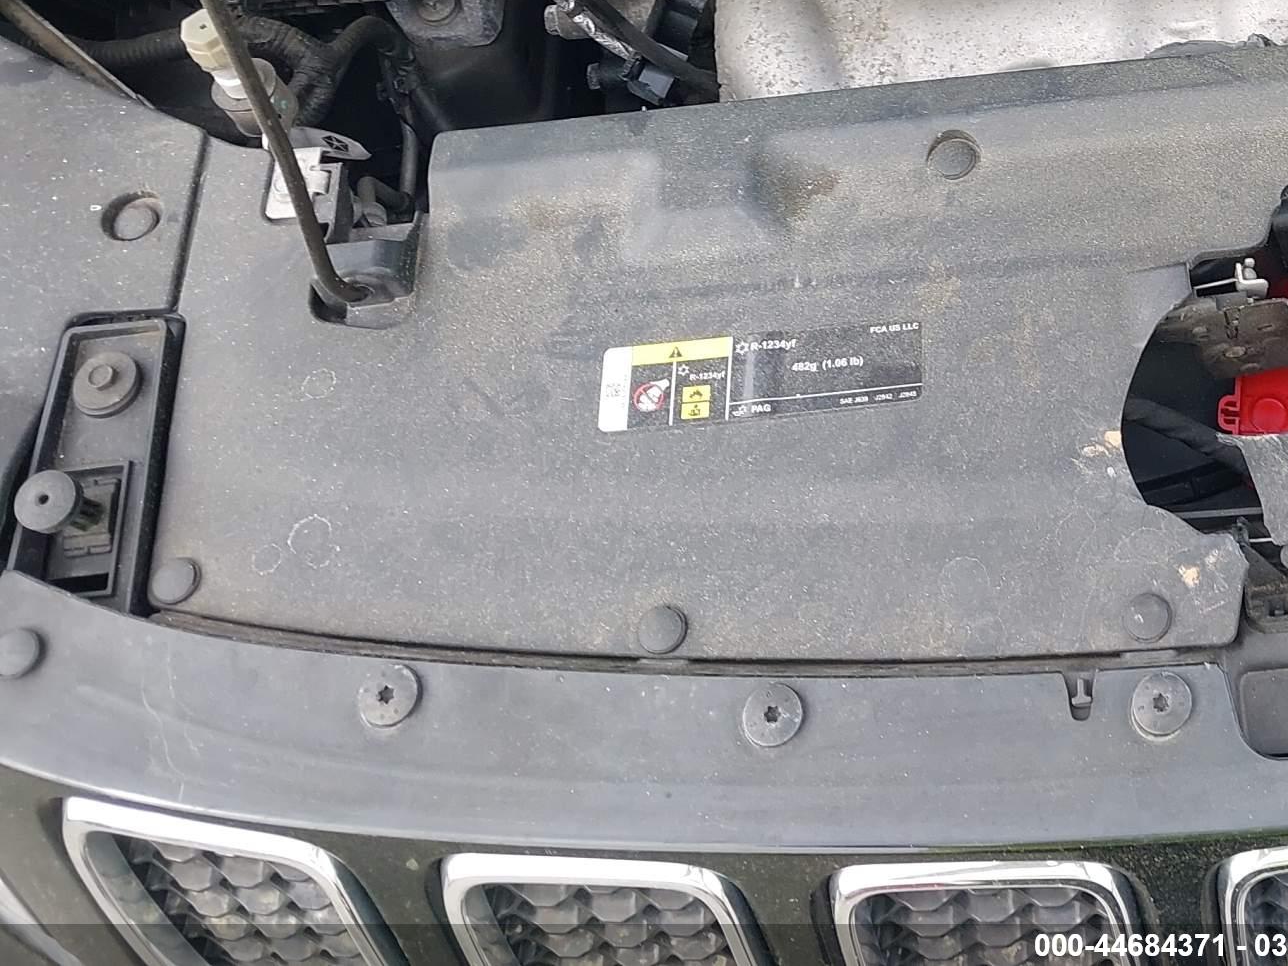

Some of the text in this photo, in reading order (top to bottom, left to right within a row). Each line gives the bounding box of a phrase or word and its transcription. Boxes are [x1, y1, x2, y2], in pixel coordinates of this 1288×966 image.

[870, 322, 919, 334] FCA US LLC
[750, 338, 796, 351] R-1234yf
[821, 357, 848, 371] (1.06
[689, 370, 726, 382] R-1234yf
[751, 404, 772, 414] PAG
